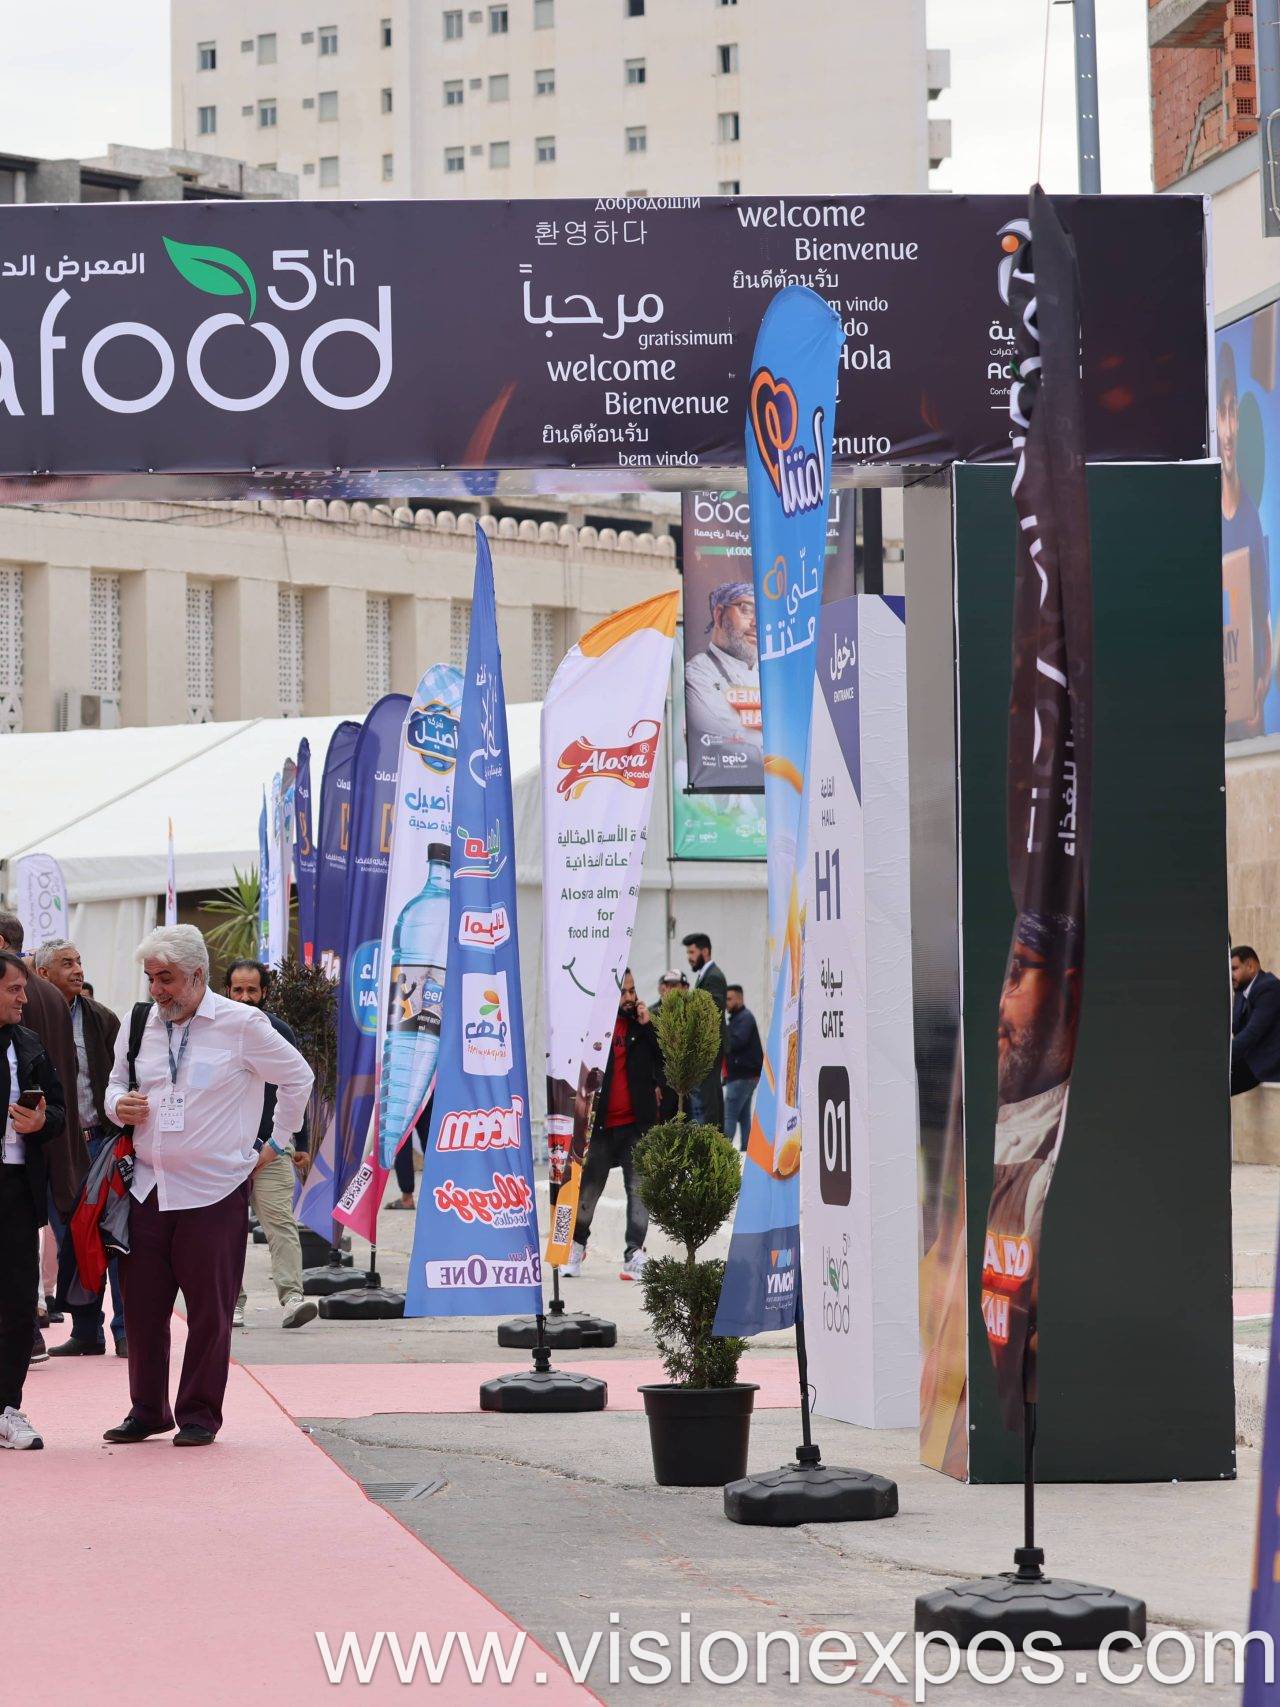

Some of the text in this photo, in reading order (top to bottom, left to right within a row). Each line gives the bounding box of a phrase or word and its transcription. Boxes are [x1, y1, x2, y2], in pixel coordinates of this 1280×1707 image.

[736, 200, 866, 229] welcome
[534, 220, 648, 246] 환영하다
[795, 237, 919, 262] Bienvenue
[45, 252, 145, 283] المعرض
[267, 248, 356, 311] 5th
[845, 296, 889, 312] vindo
[638, 329, 733, 350] gratissimum
[546, 353, 676, 383] welcome
[605, 391, 729, 416] Bienvenue
[542, 422, 650, 445] ยินดีต้อนรับ
[618, 450, 699, 467] bem vindo
[833, 687, 855, 703] ENTRANCE
[577, 750, 648, 774] Alosra
[821, 808, 836, 827] HALL
[815, 848, 841, 922] H1
[597, 908, 615, 921] for
[821, 1011, 845, 1038] GATE
[823, 1098, 847, 1172] 01
